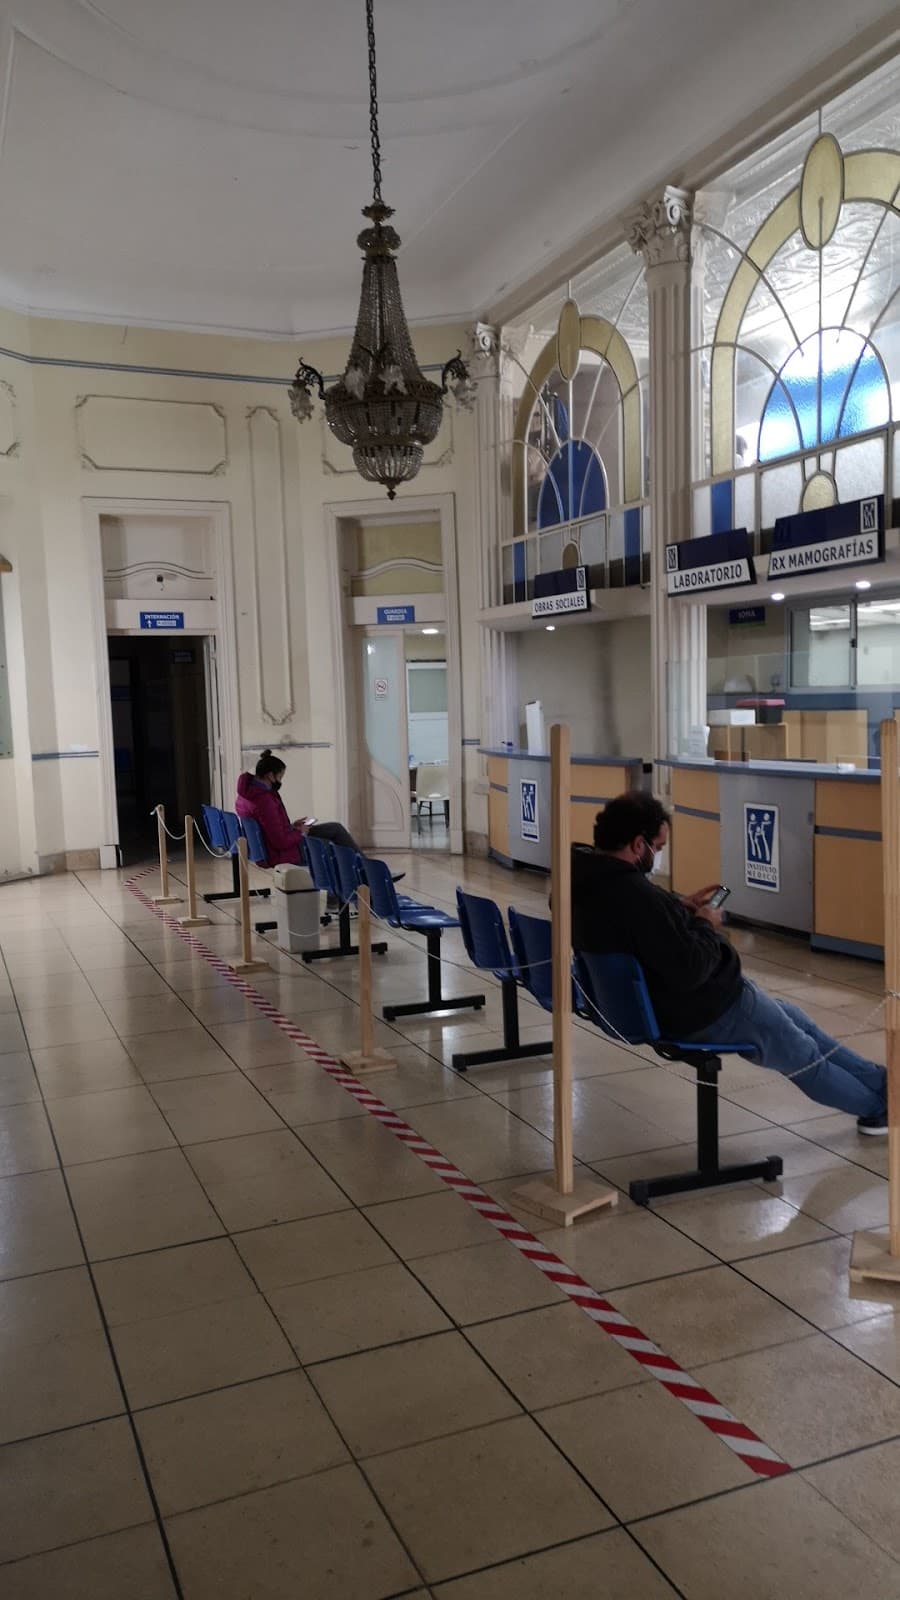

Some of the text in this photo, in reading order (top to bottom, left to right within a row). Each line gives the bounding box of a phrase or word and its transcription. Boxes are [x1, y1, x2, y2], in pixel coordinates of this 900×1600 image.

[772, 539, 874, 571] RX MAMOGRAFÍAS
[673, 564, 742, 589] LABORATORIO
[534, 595, 585, 612] OBRAS SOCIALES
